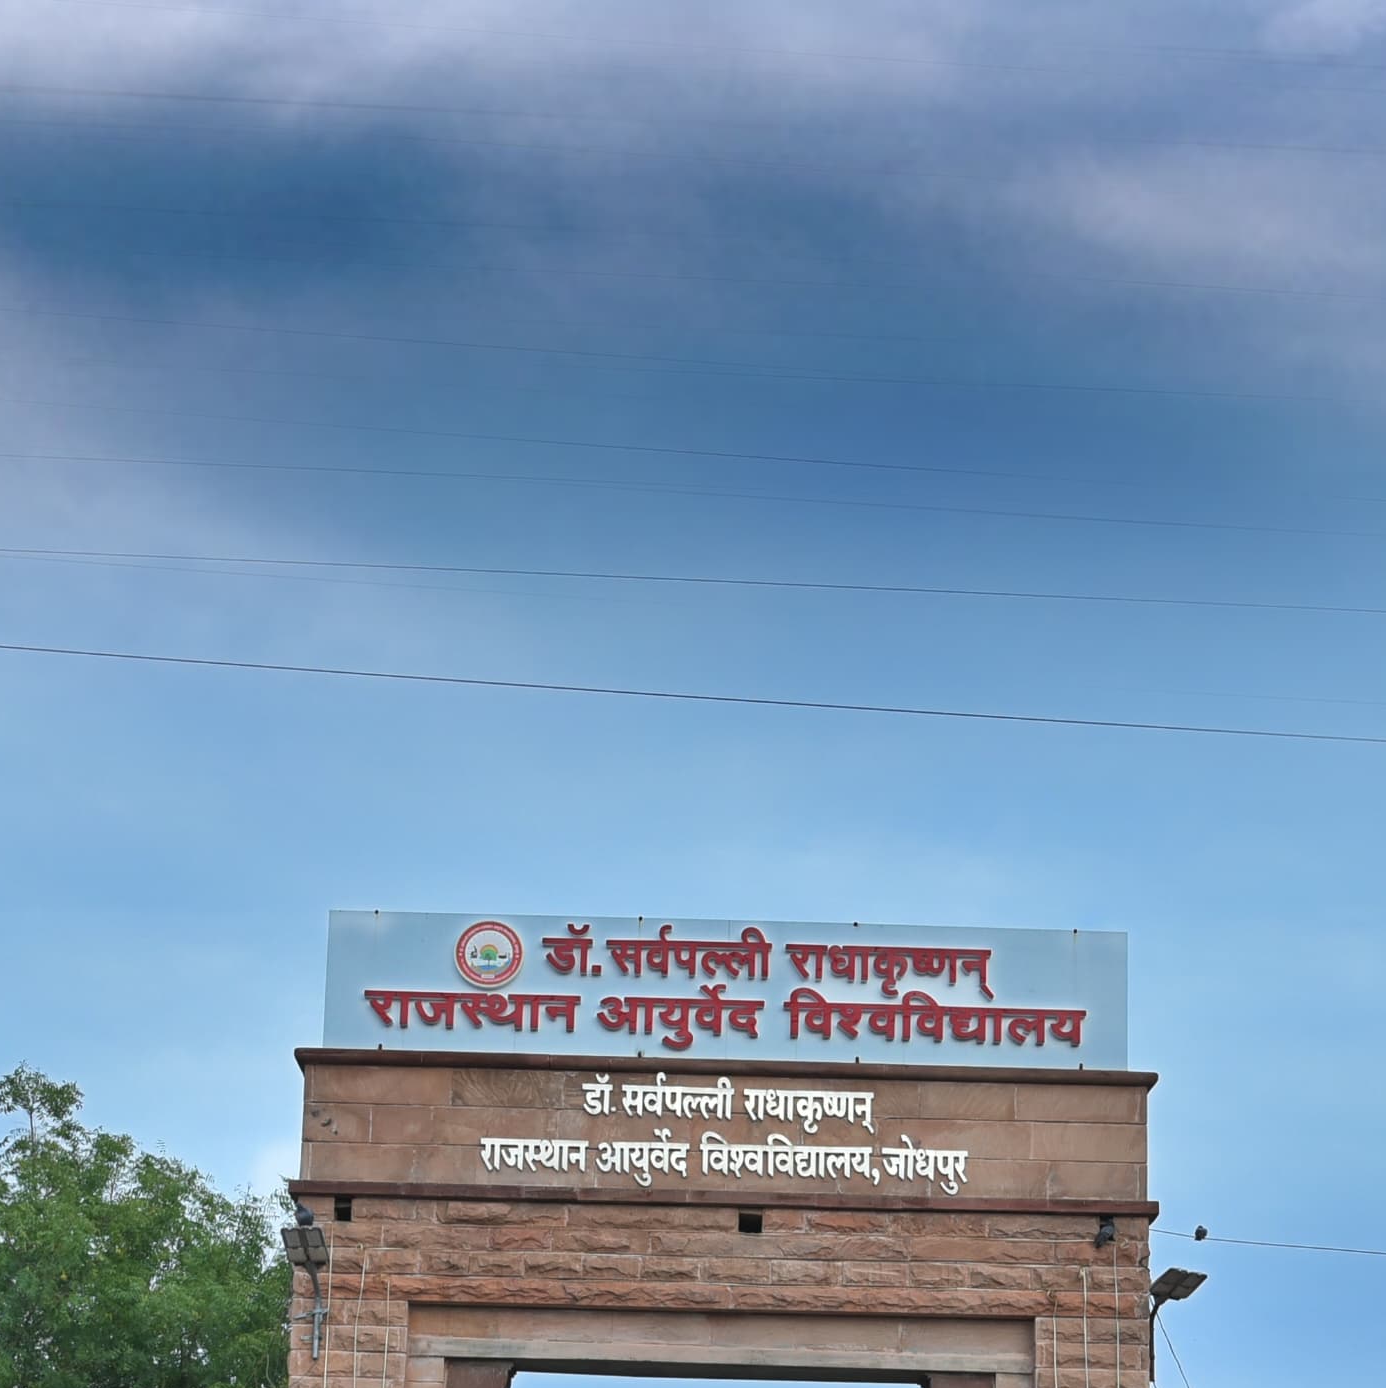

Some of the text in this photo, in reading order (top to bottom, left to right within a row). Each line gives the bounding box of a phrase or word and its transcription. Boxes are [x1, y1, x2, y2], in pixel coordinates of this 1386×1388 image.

[542, 923, 602, 977] डॉ.
[606, 924, 773, 981] सर्वपल्ली
[785, 943, 995, 1001] राधाकृष्णन्
[364, 983, 1087, 1051] राजस्थान आयुर्वेद विश्वविद्यालय
[582, 1071, 875, 1134] डॉ. सर्वपल्ली राधाकृष्णन्
[480, 1137, 589, 1173] राजस्थान
[595, 1128, 690, 1187] आयुर्वेद
